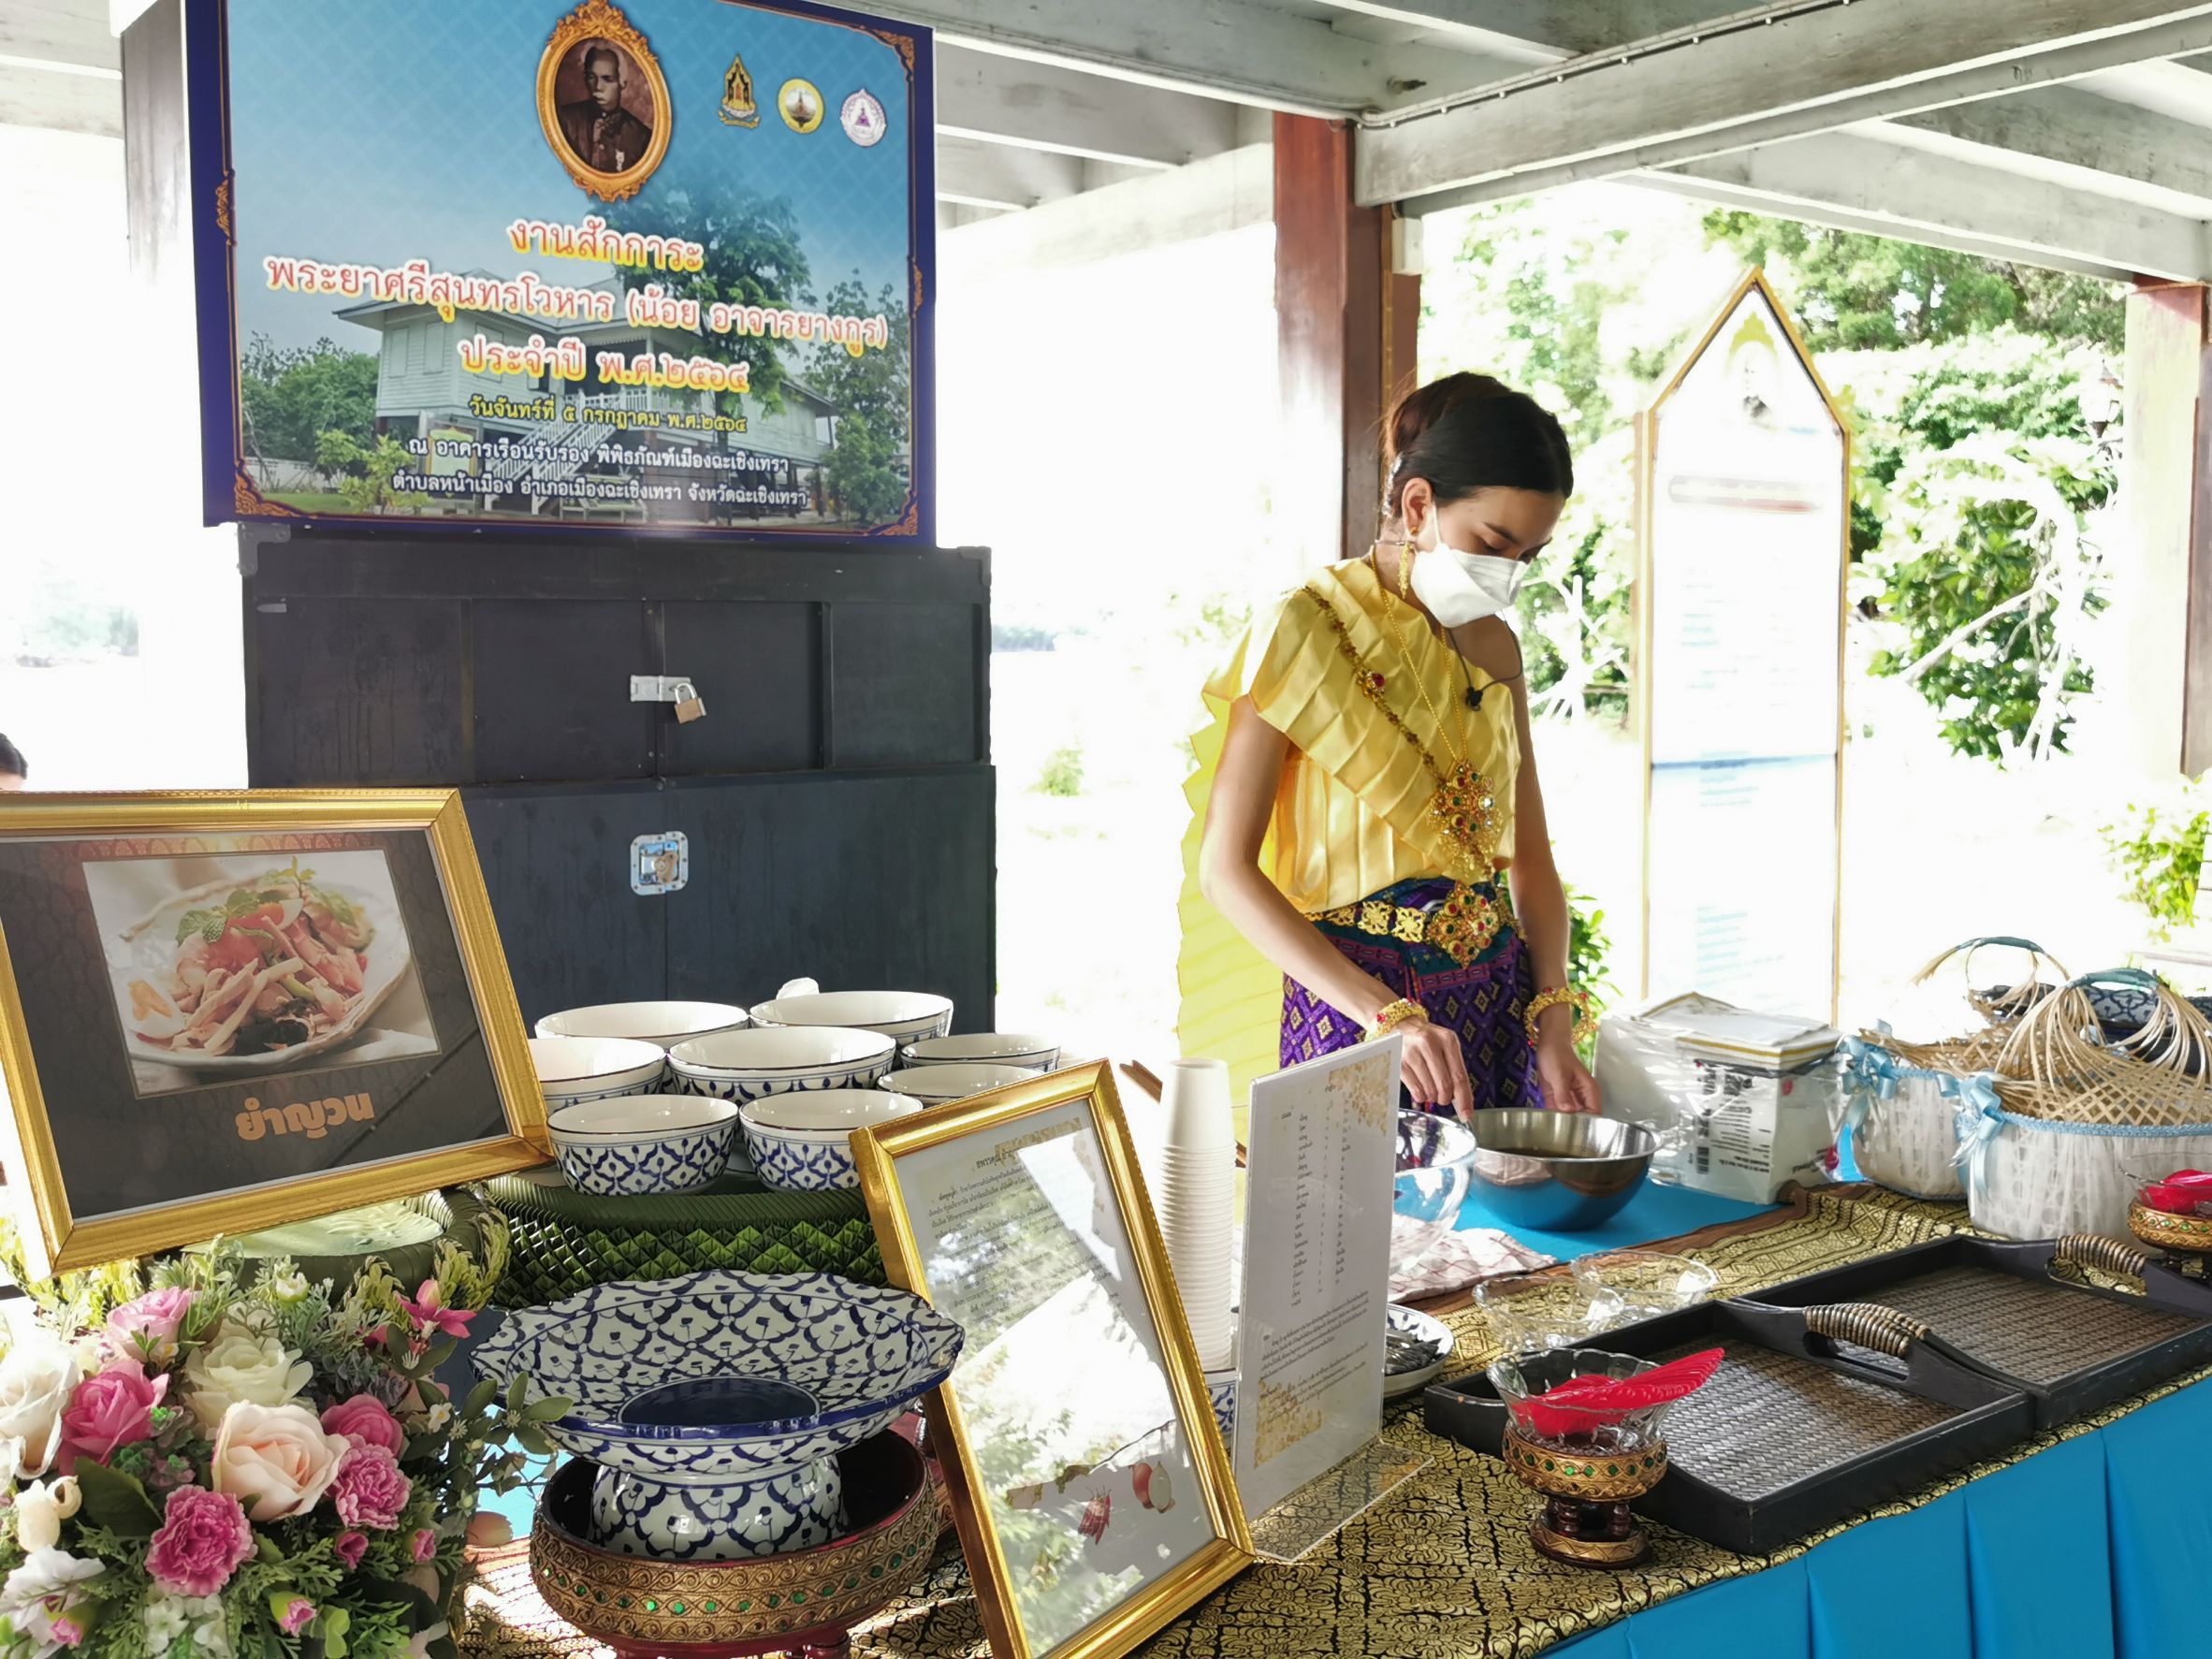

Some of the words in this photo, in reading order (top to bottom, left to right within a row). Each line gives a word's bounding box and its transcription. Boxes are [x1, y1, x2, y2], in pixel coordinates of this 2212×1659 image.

[508, 216, 703, 272] งานสักการะ
[264, 256, 615, 322] พระยาศรีสุนทรโวหาร
[626, 284, 700, 328] (น้อย
[710, 303, 889, 357] อาจารยางกูร)
[458, 334, 586, 381] ประจำปี
[597, 351, 749, 393] พ.ศ.๒๕๖๔
[469, 393, 556, 421] วันจันทร์ที่
[597, 443, 790, 473] พิพิธภัณฑ์เมืองฉะเชิงเทรา
[392, 469, 513, 495] ตำบลหน้าเมือง
[520, 475, 681, 501] อำเภอเมืองฉะเชิงเทรา
[688, 482, 808, 505] จังหวัดฉะเชิงเทรา
[235, 1093, 375, 1141] ยำญวน
